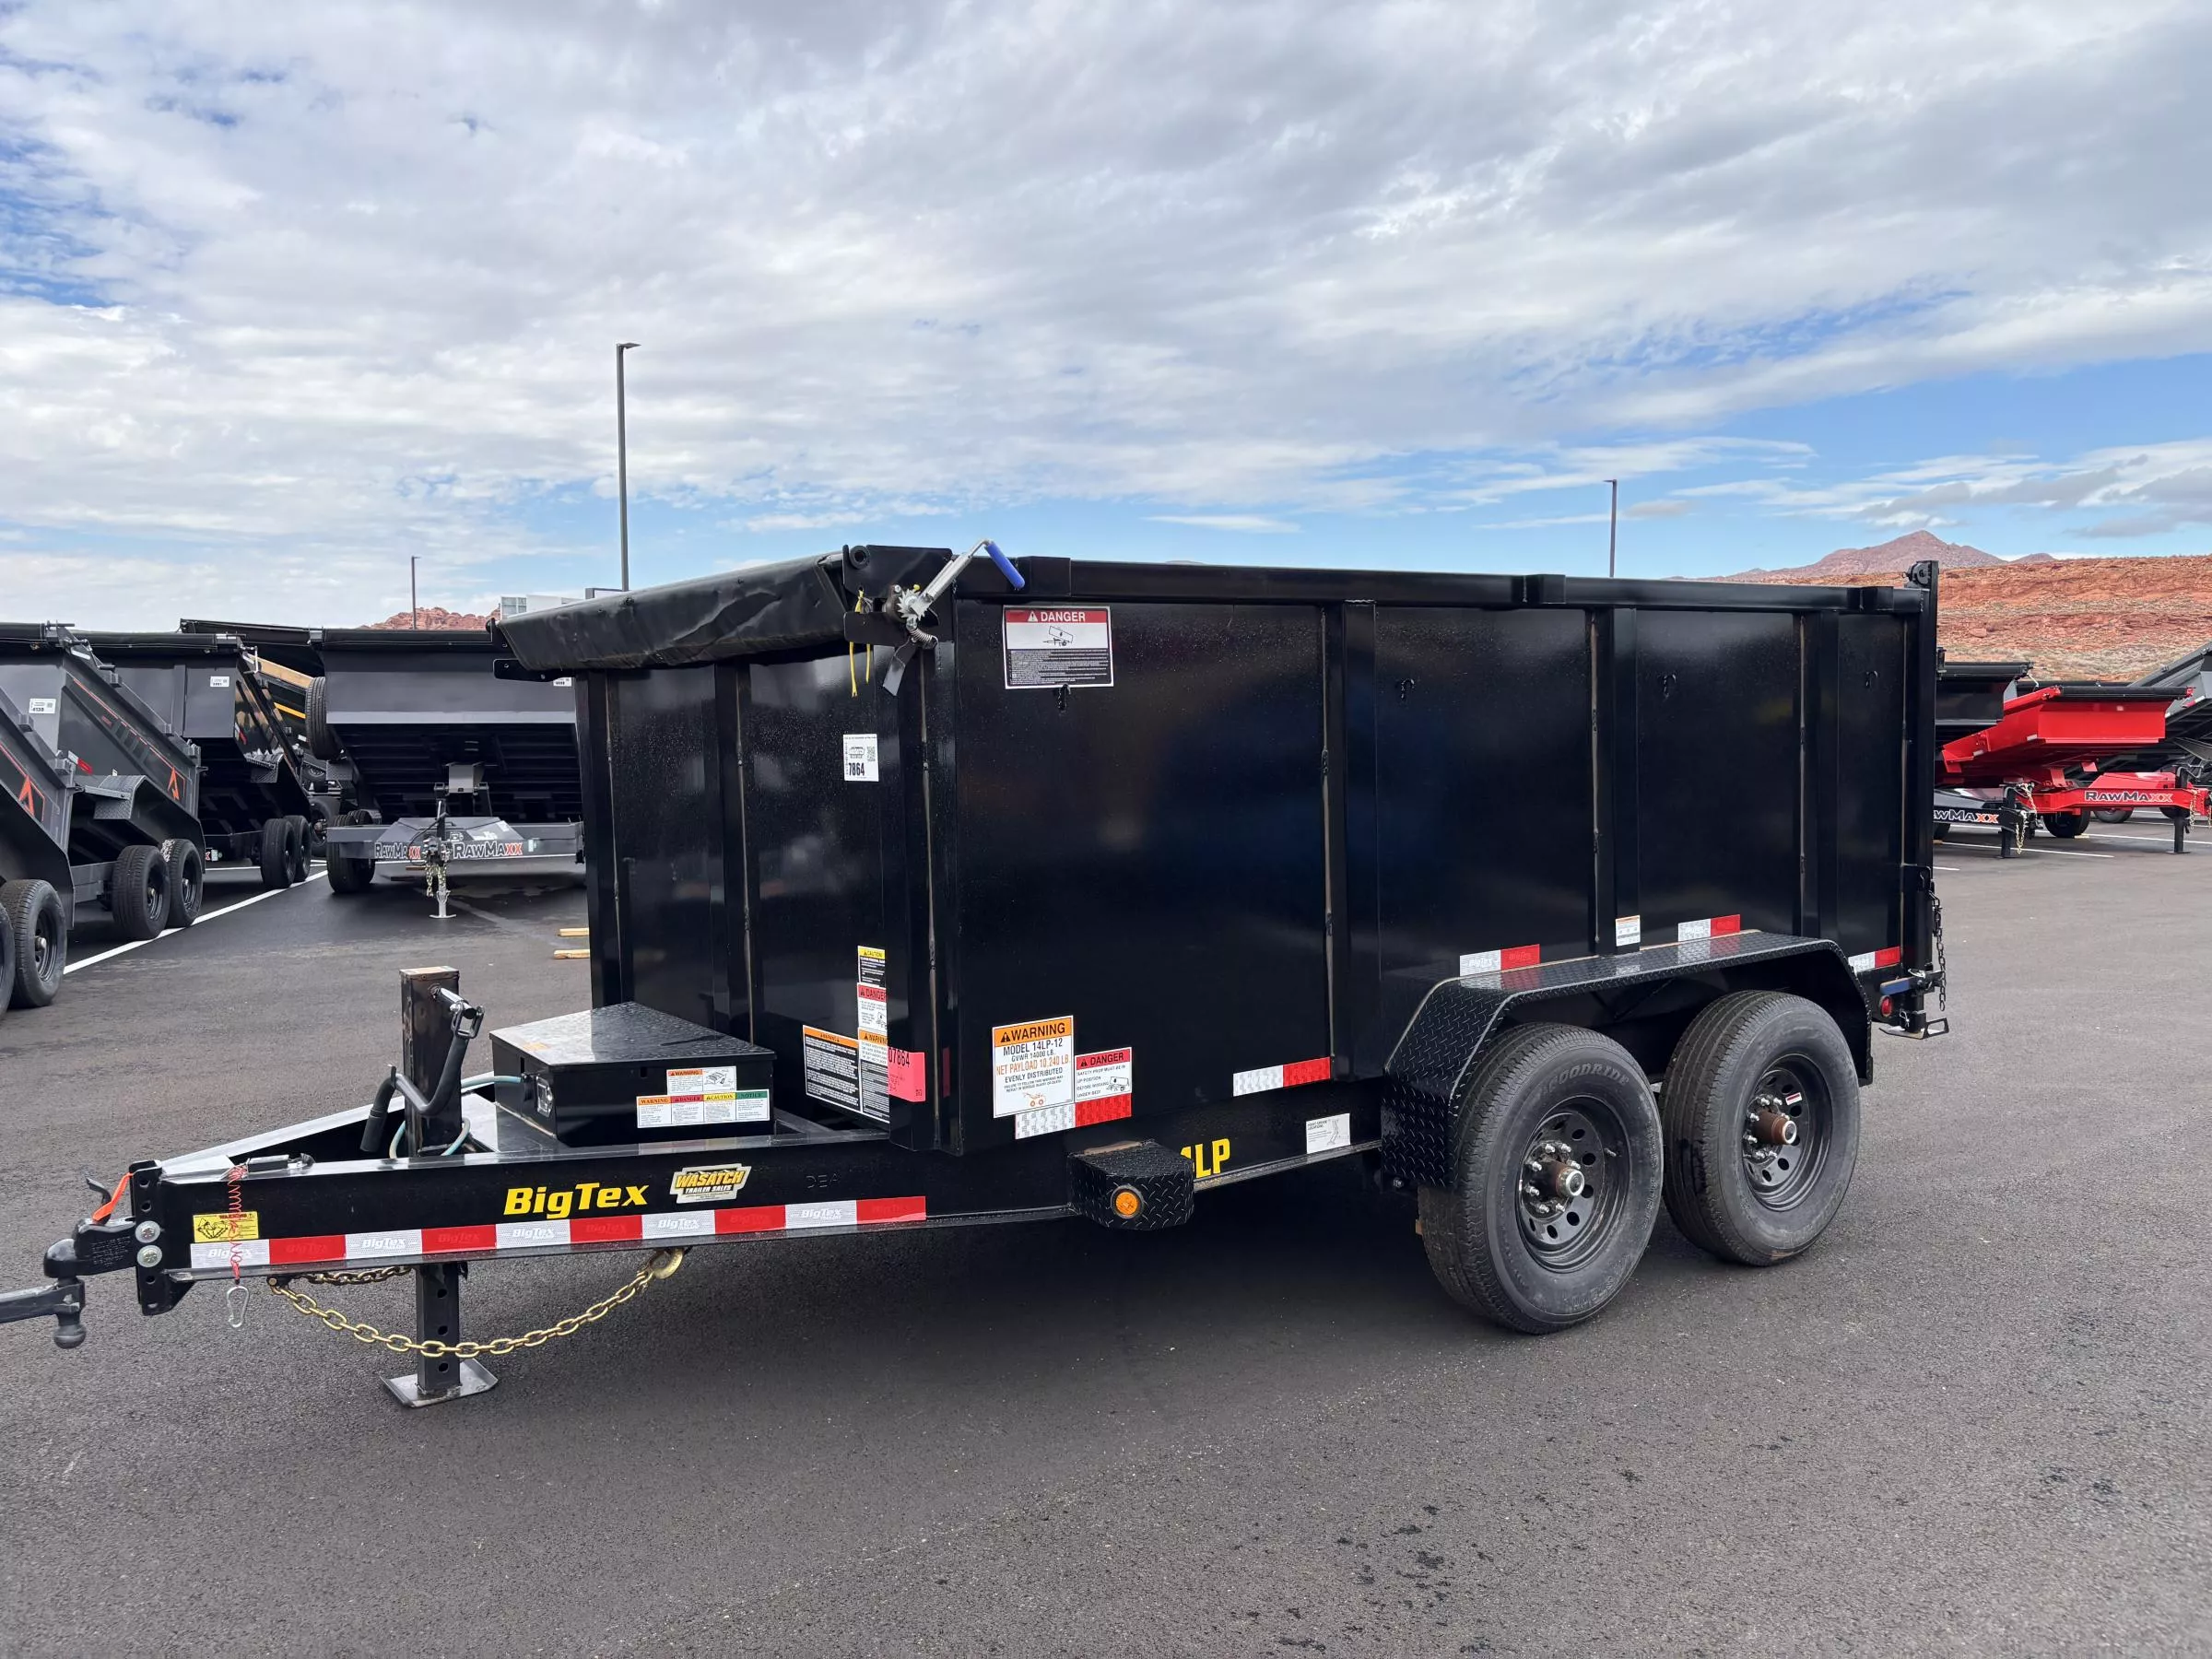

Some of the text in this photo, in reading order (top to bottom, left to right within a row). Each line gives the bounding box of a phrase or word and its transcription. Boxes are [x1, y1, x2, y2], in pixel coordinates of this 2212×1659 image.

[1041, 612, 1086, 622] DANGER
[848, 762, 865, 776] 7864
[1934, 808, 1999, 824] WMAXX
[1011, 1022, 1065, 1041] WARNING
[1004, 1038, 1064, 1056] MODEL 14LP-12
[888, 1047, 910, 1067] 07864
[1012, 1053, 1029, 1063] GVWR
[1030, 1051, 1046, 1059] 14000
[1090, 1052, 1124, 1065] DANGER
[996, 1065, 1008, 1076] NET
[1010, 1059, 1038, 1074] PAYLOAD
[1062, 1054, 1069, 1065] LB
[1005, 1067, 1063, 1083] EVENLY DISTRIBUTED
[676, 1170, 746, 1189] WASATCH
[685, 1186, 712, 1194] TRAILER
[503, 1182, 650, 1219] BigTex
[801, 1207, 843, 1219] BigTex
[657, 1218, 700, 1230] BigTex
[512, 1227, 555, 1240] BigTex
[362, 1237, 406, 1249] BigTex
